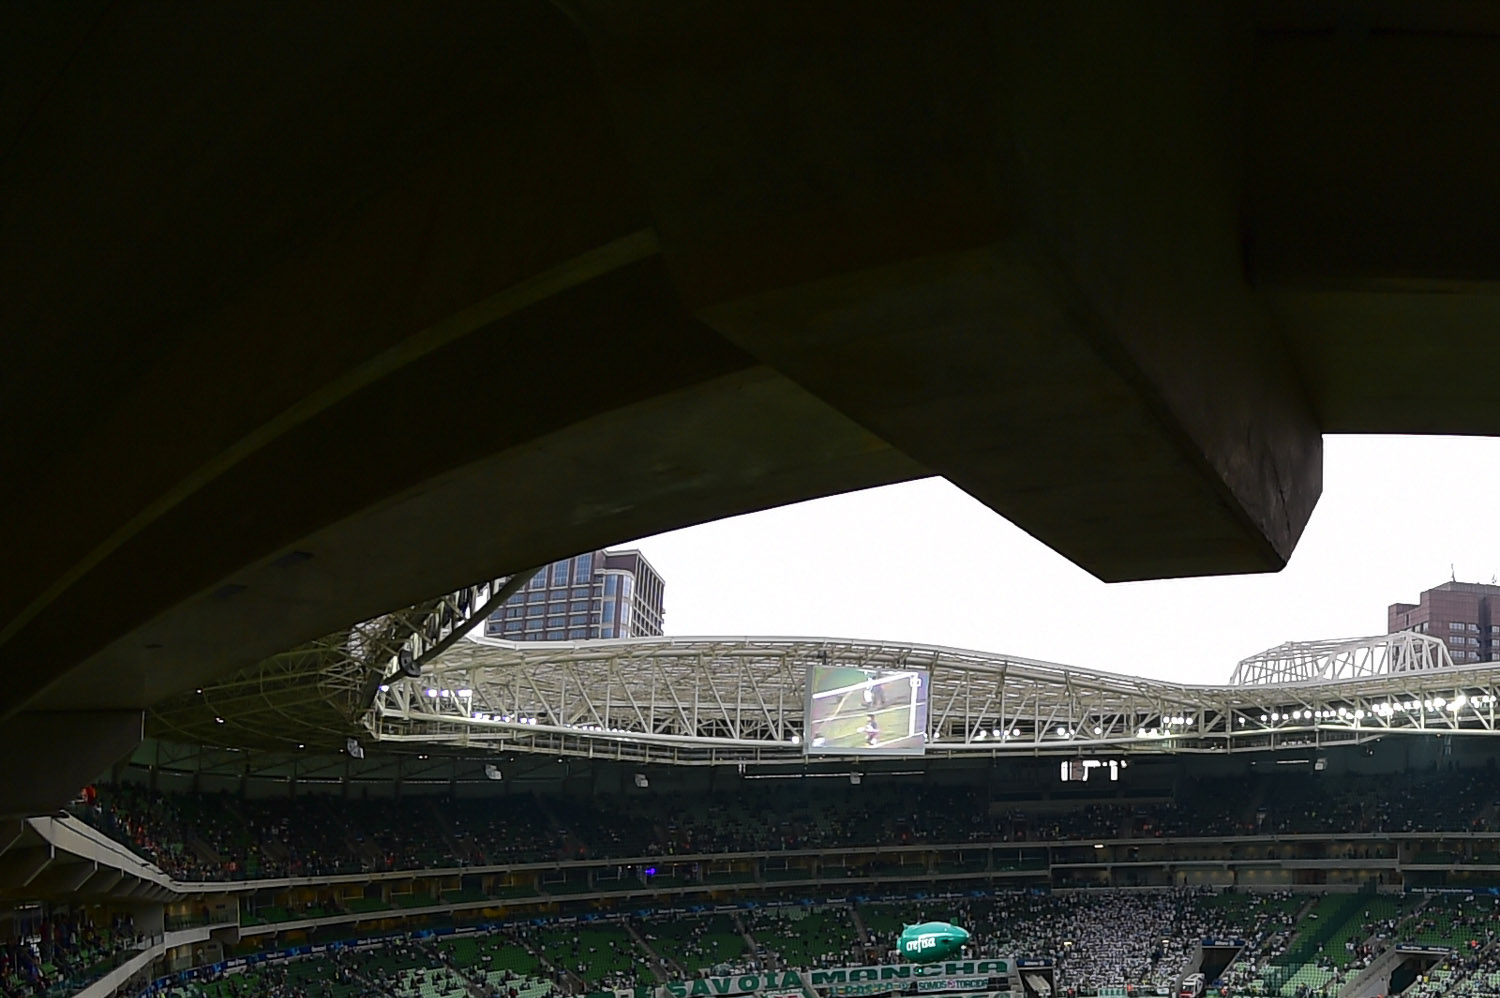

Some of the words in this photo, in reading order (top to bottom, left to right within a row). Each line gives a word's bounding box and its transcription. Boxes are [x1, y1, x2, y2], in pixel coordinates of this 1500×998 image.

[906, 935, 936, 953] crefisa
[667, 970, 801, 998] SAVOIA
[811, 961, 1008, 985] MANCHA
